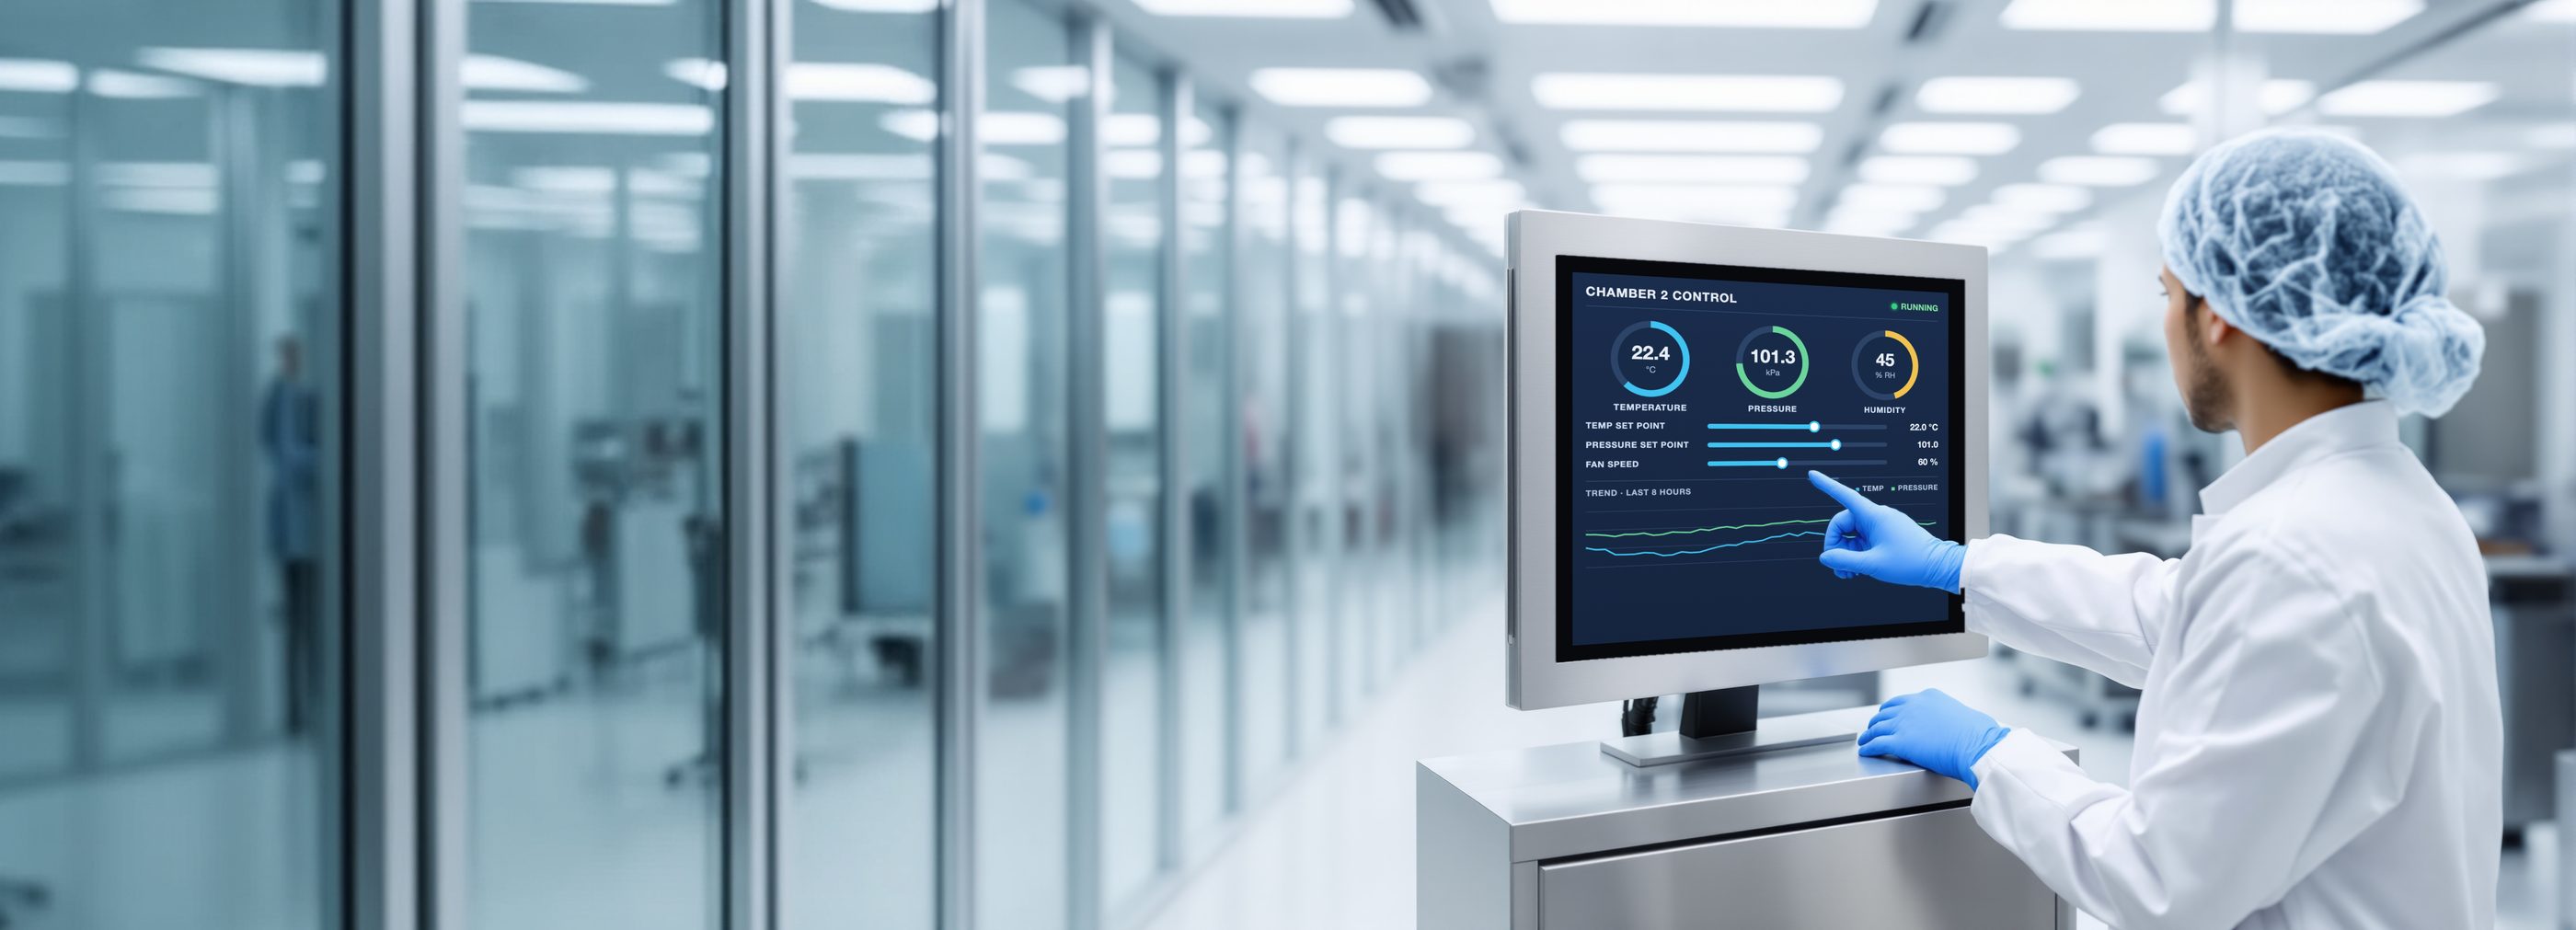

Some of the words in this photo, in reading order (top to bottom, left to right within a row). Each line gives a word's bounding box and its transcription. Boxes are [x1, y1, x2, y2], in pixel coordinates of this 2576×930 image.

[1586, 286, 1656, 299] CHAMBER
[1660, 290, 1668, 300] 2
[1672, 290, 1737, 303] CONTROL
[1900, 303, 1939, 312] RUNNING
[1632, 344, 1670, 361] 22.4
[1750, 349, 1795, 365] 101.3
[1875, 353, 1895, 367] 45
[1613, 403, 1687, 412] TEMPERATURE
[1918, 458, 1928, 466] 60
[1930, 458, 1938, 466] %
